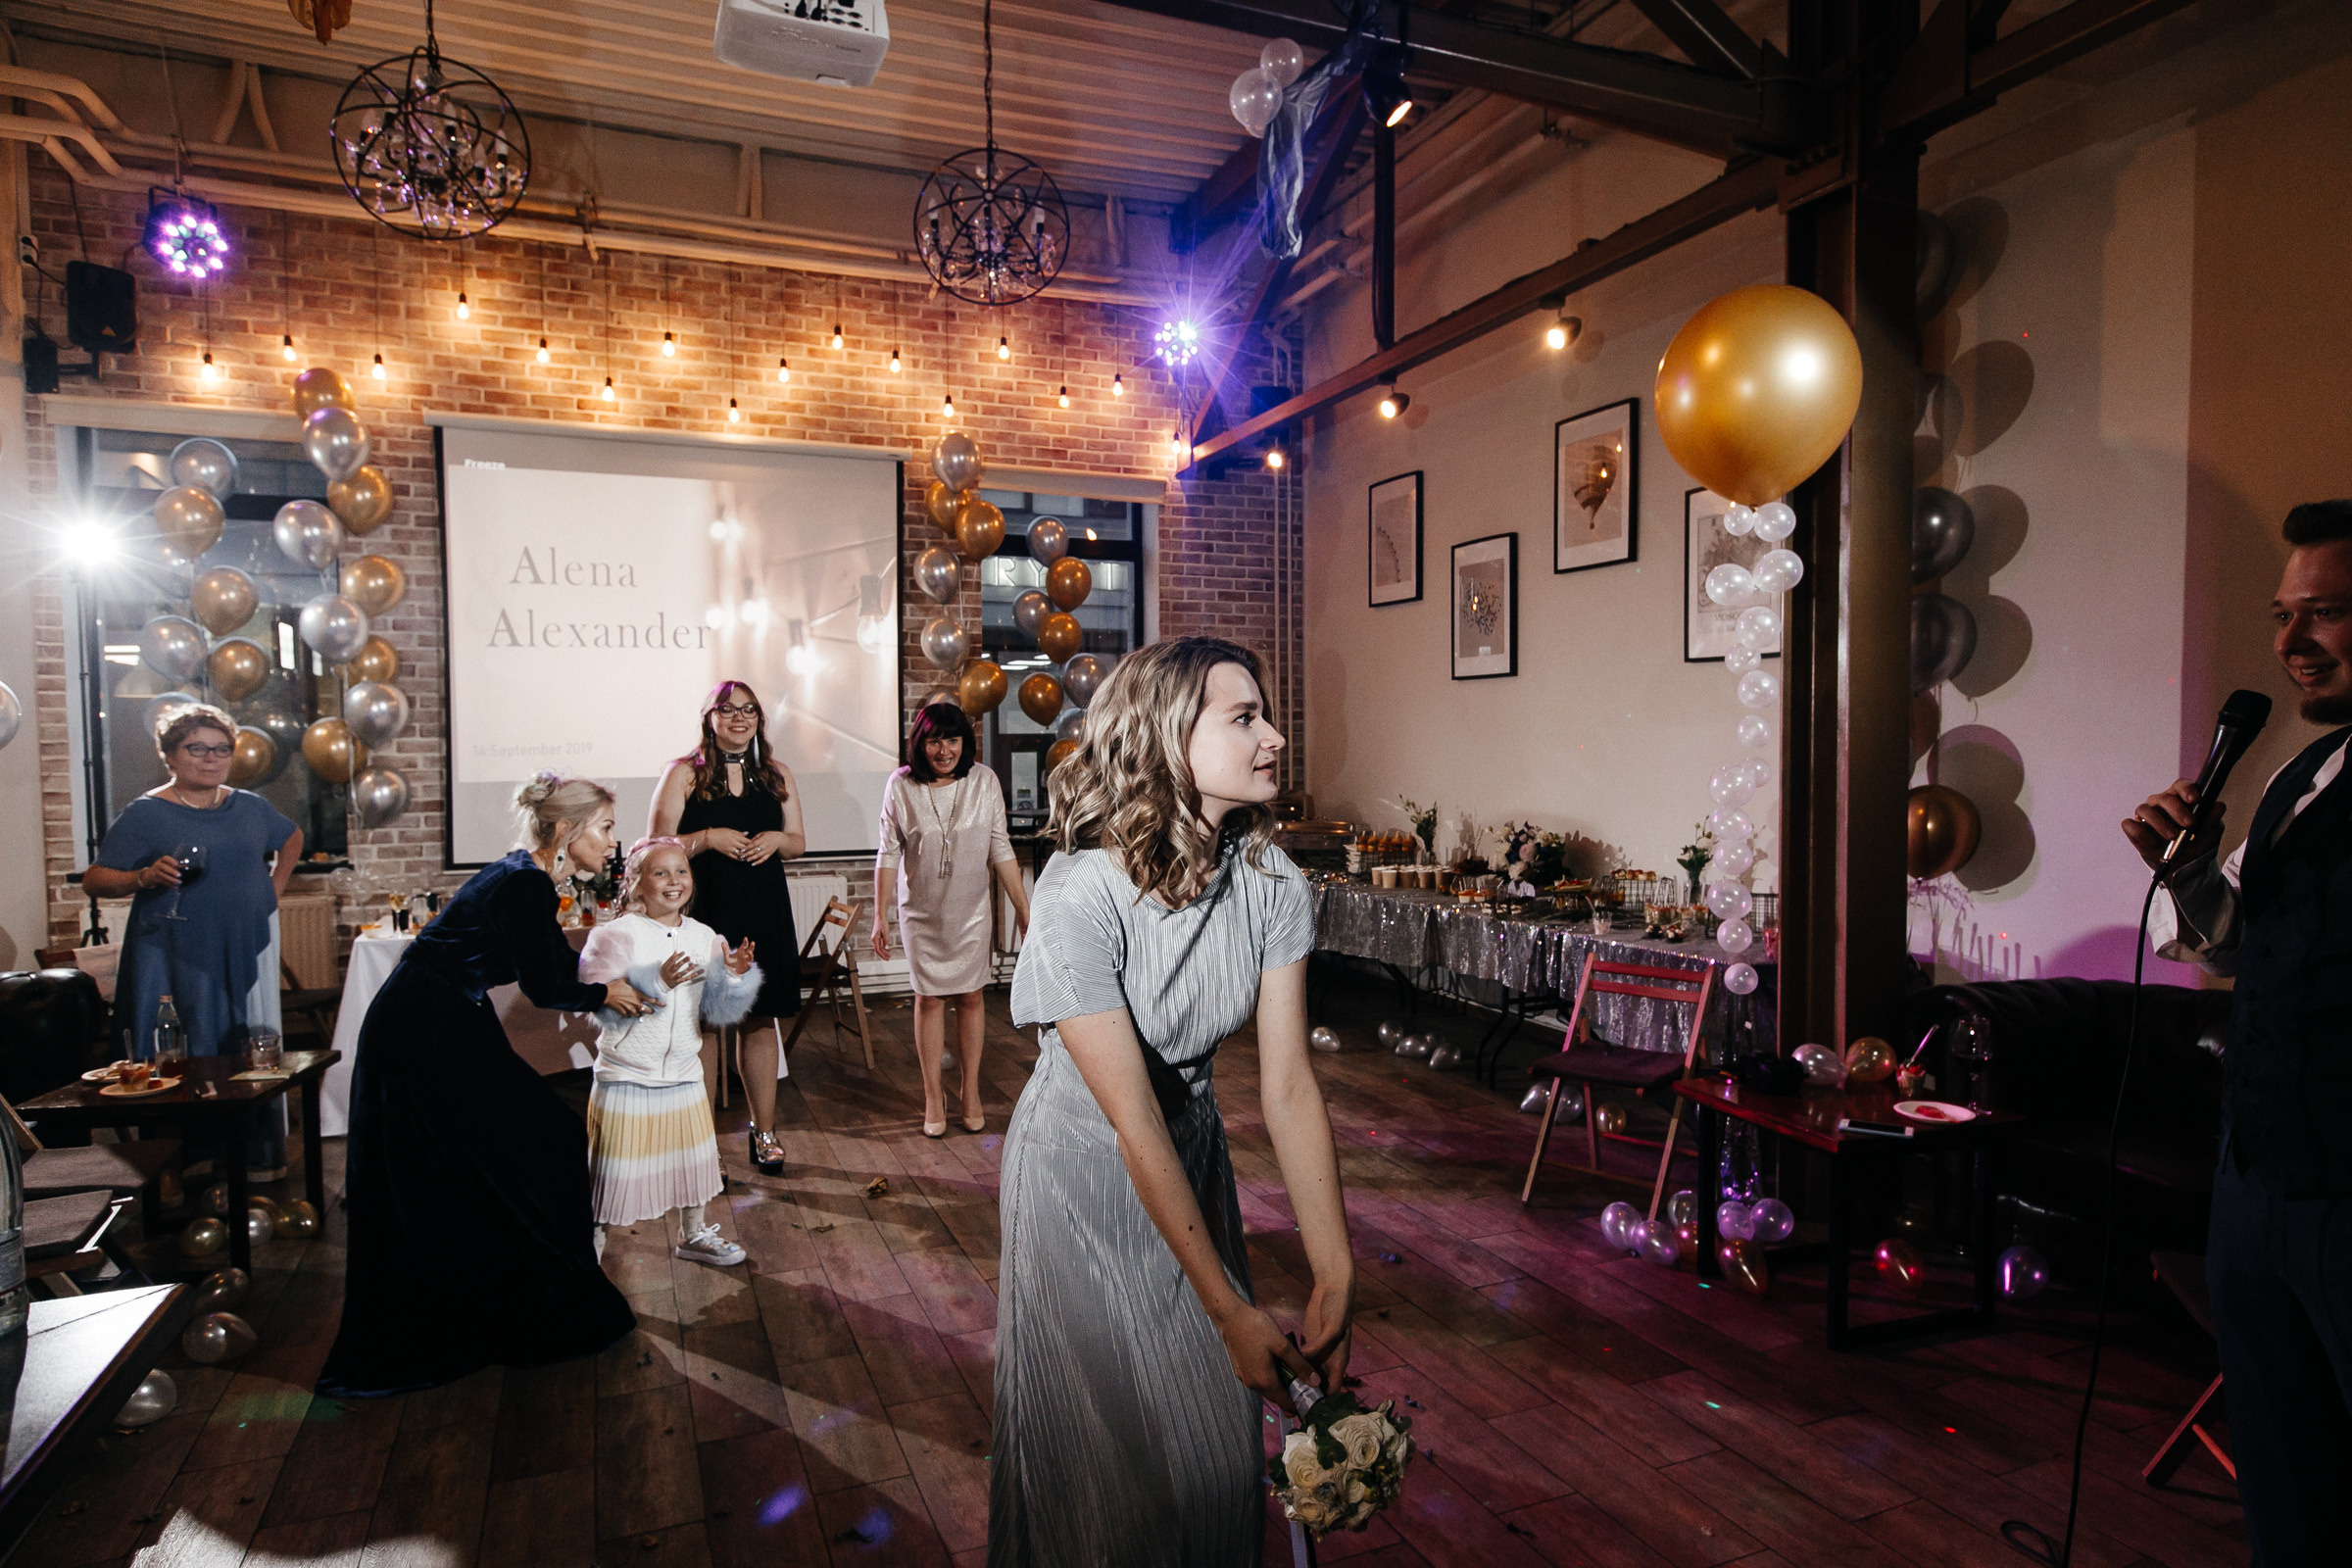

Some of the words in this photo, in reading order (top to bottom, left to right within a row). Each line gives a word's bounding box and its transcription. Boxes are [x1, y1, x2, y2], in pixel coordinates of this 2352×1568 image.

[464, 458, 506, 471] Freeze
[510, 545, 638, 588] Alena
[486, 608, 712, 650] Alexander
[489, 743, 563, 760] September
[565, 741, 593, 756] 2019
